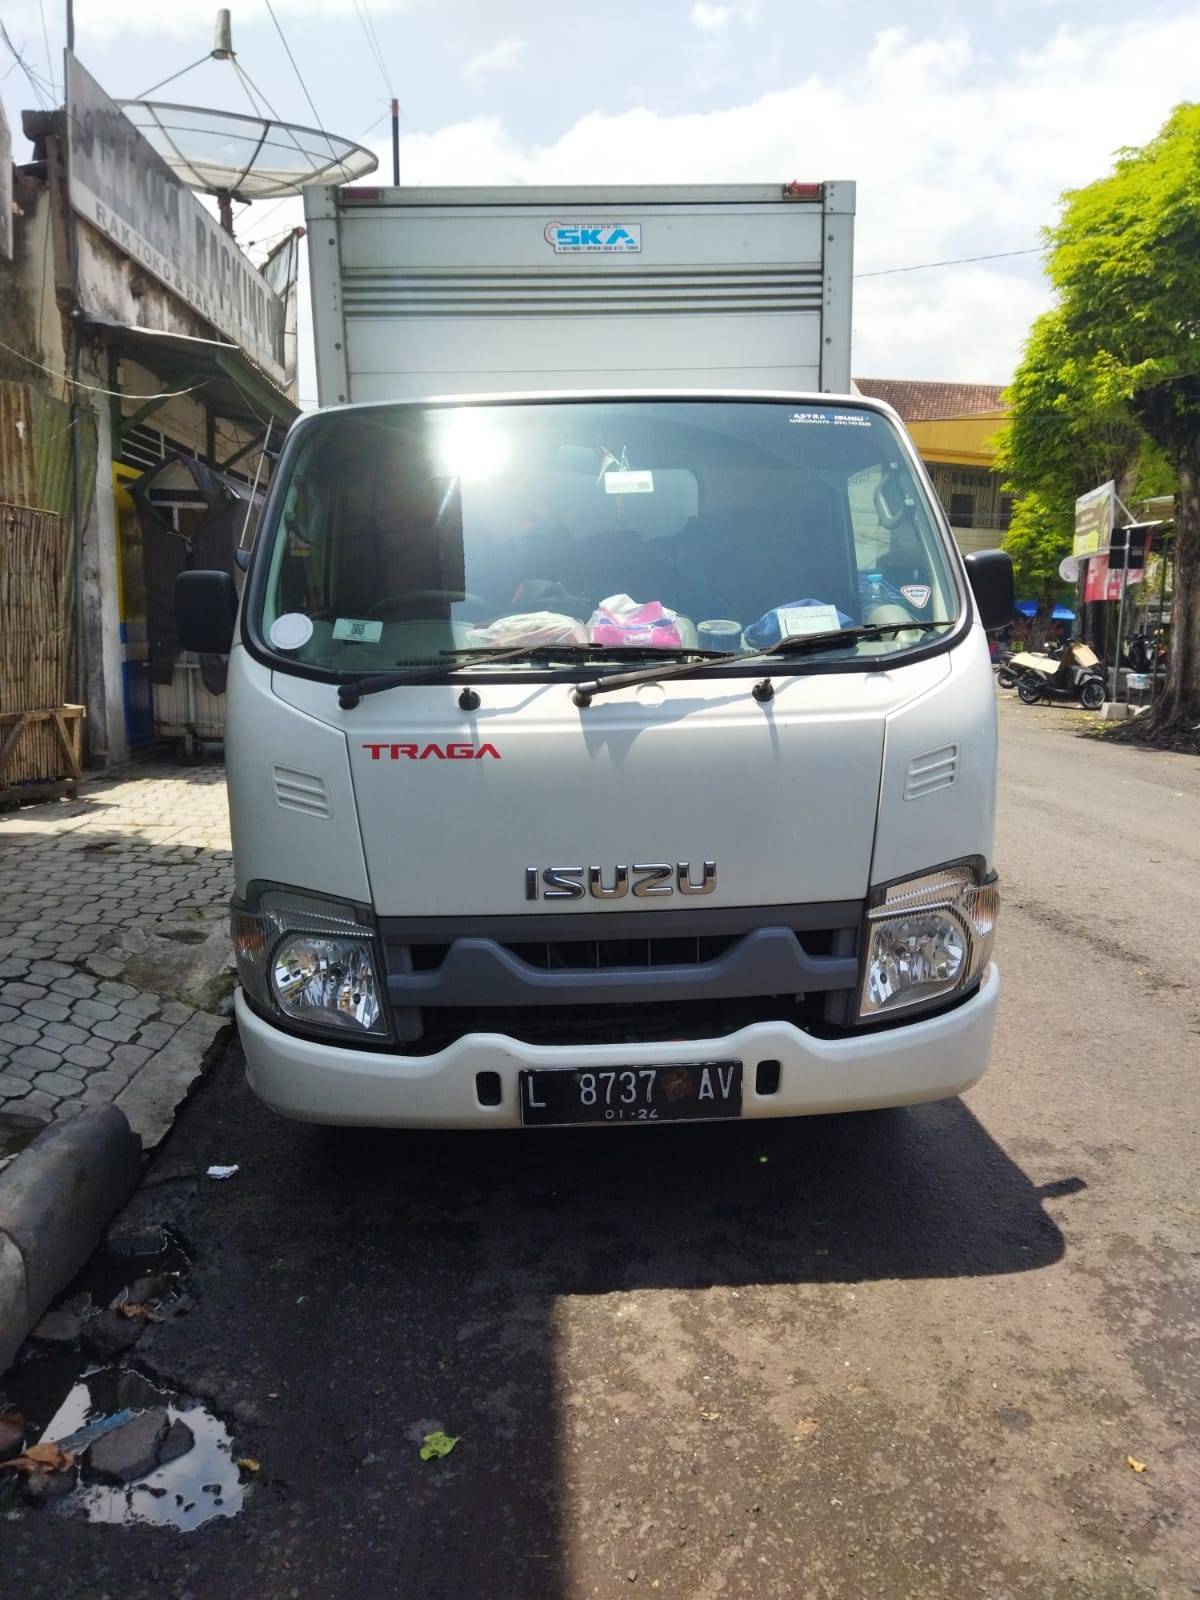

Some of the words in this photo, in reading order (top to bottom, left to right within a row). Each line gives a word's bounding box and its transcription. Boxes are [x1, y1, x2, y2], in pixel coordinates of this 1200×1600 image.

[96, 201, 130, 246] RAK
[134, 235, 170, 281] TOKO
[557, 229, 636, 245] SKA
[362, 743, 502, 760] TRAGA
[526, 861, 716, 901] ISUZU
[528, 1075, 546, 1107] L
[579, 1070, 656, 1105] 8737
[698, 1066, 734, 1100] AV
